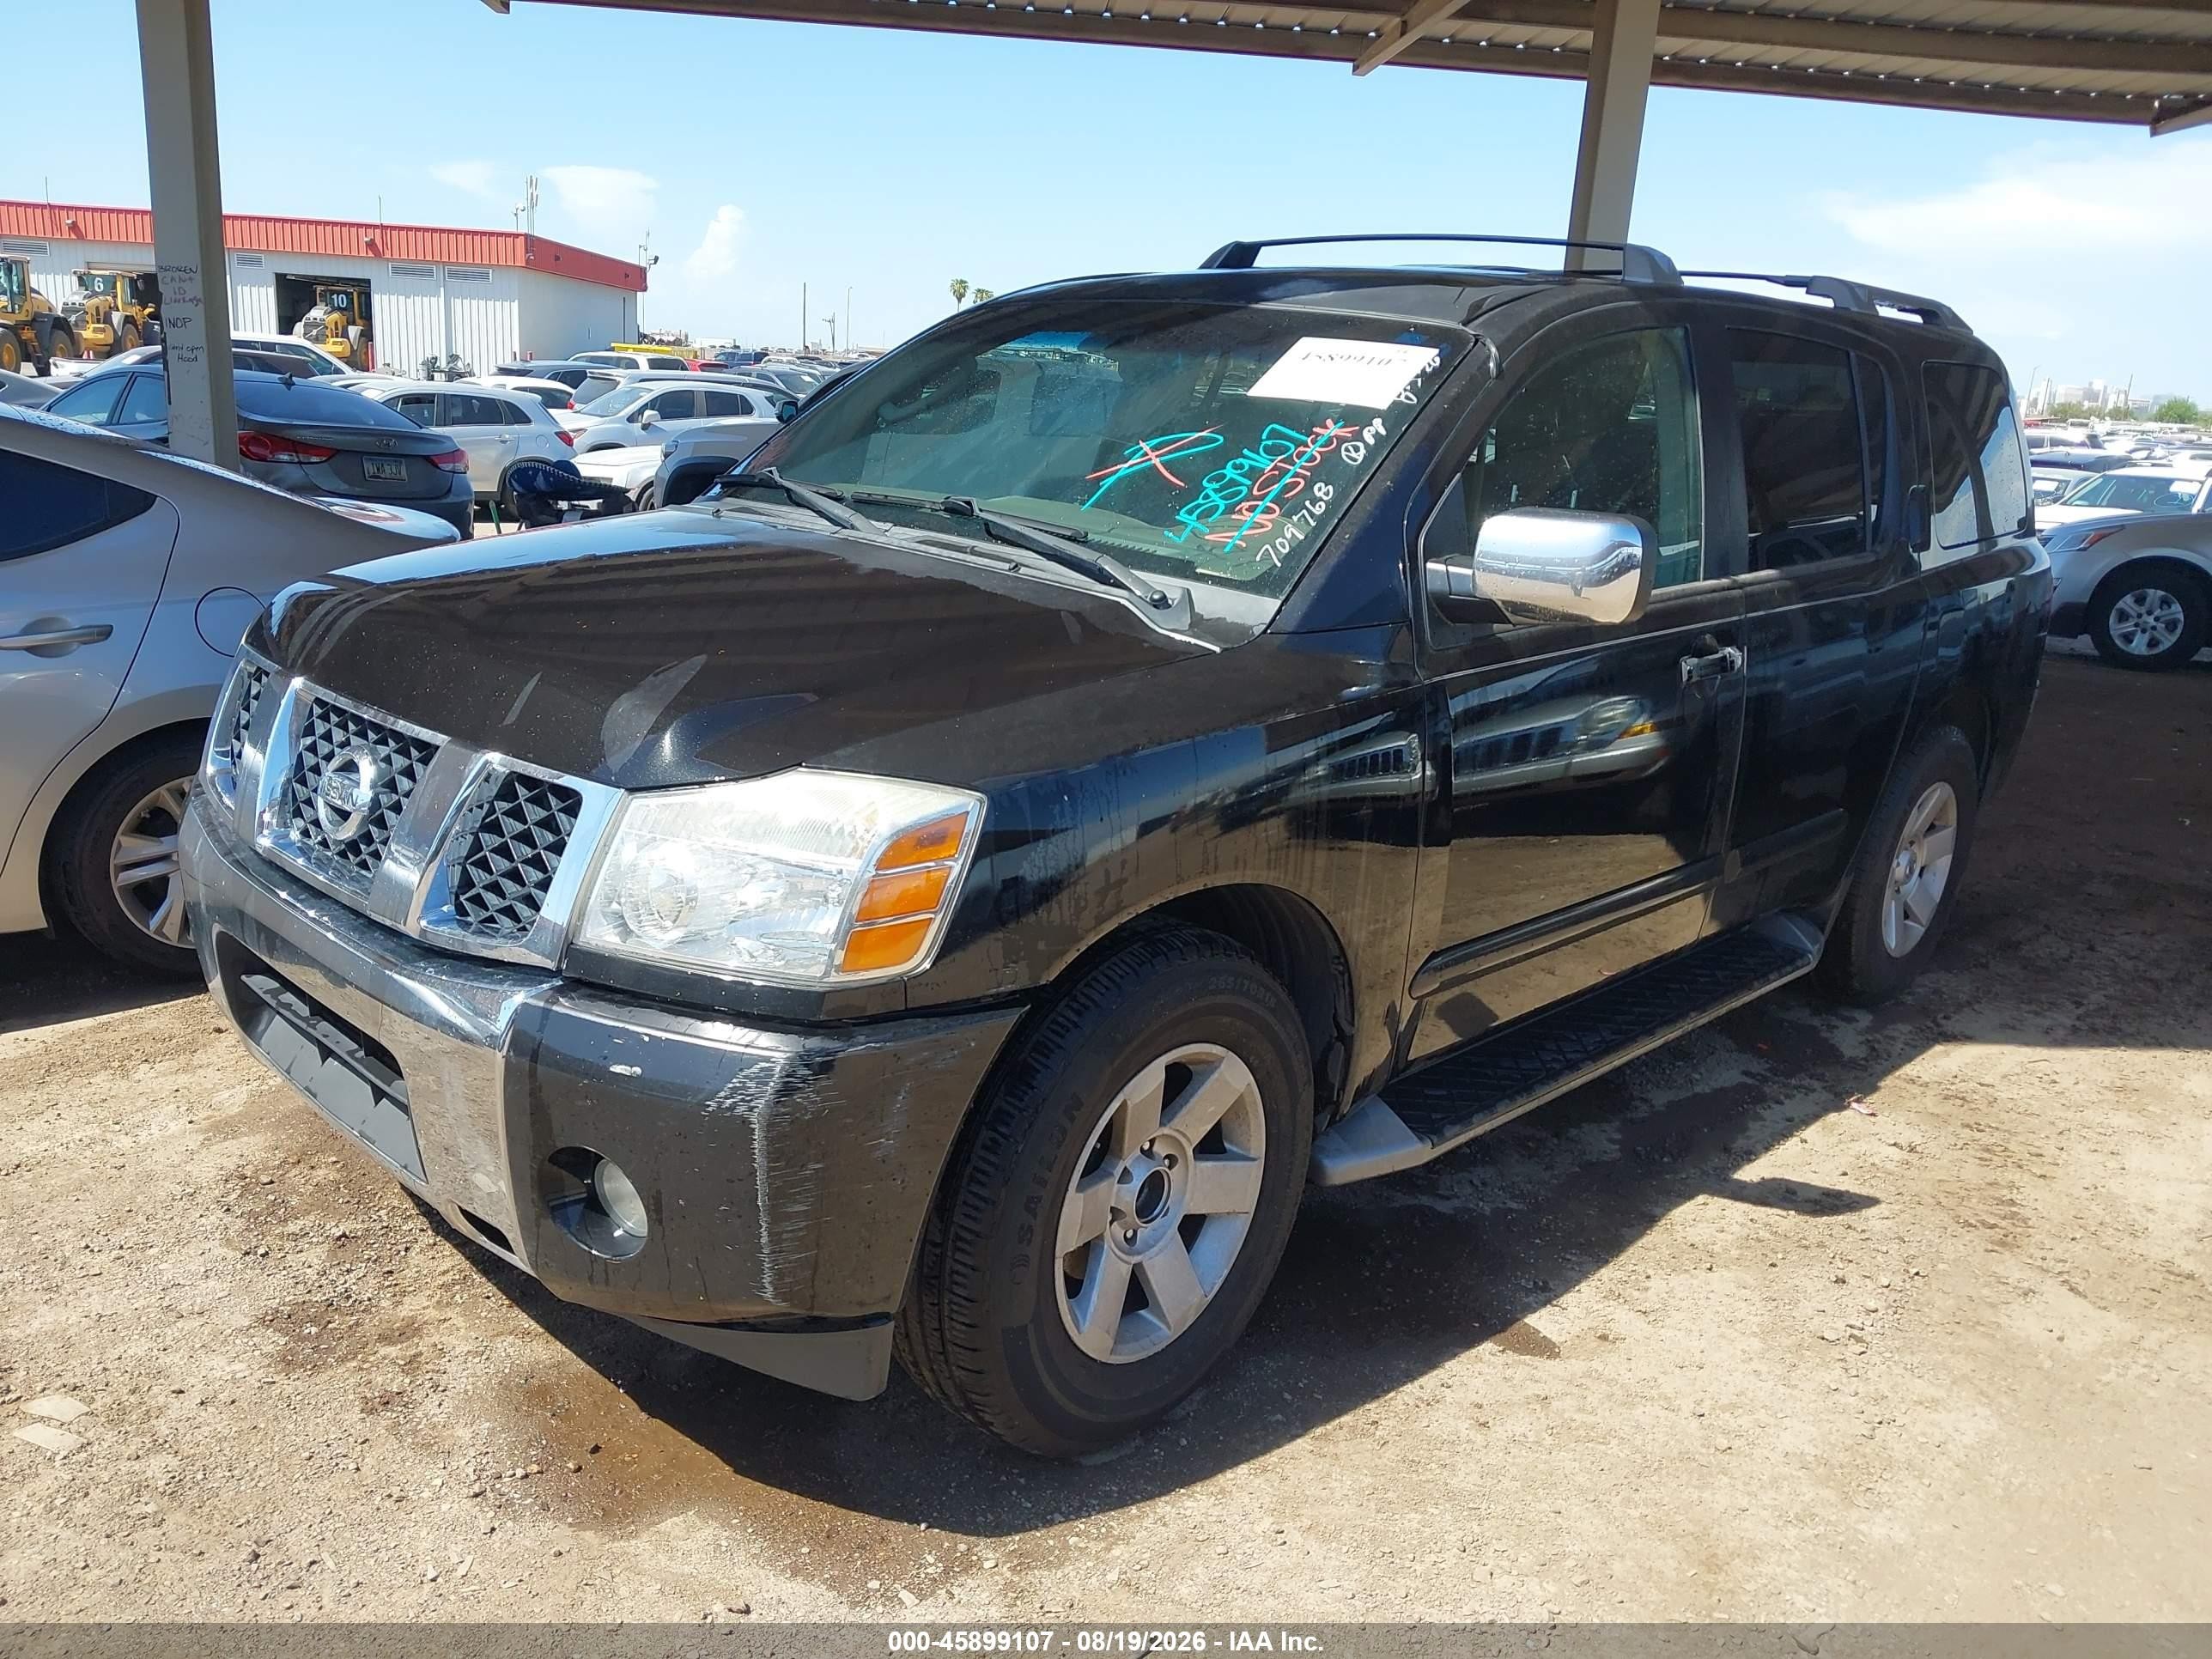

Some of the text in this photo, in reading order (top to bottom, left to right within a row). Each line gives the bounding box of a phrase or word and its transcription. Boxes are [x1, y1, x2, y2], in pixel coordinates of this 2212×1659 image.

[94, 277, 104, 292] 6
[331, 294, 347, 308] 10
[165, 317, 192, 329] INOP
[1256, 482, 1334, 568] 709768
